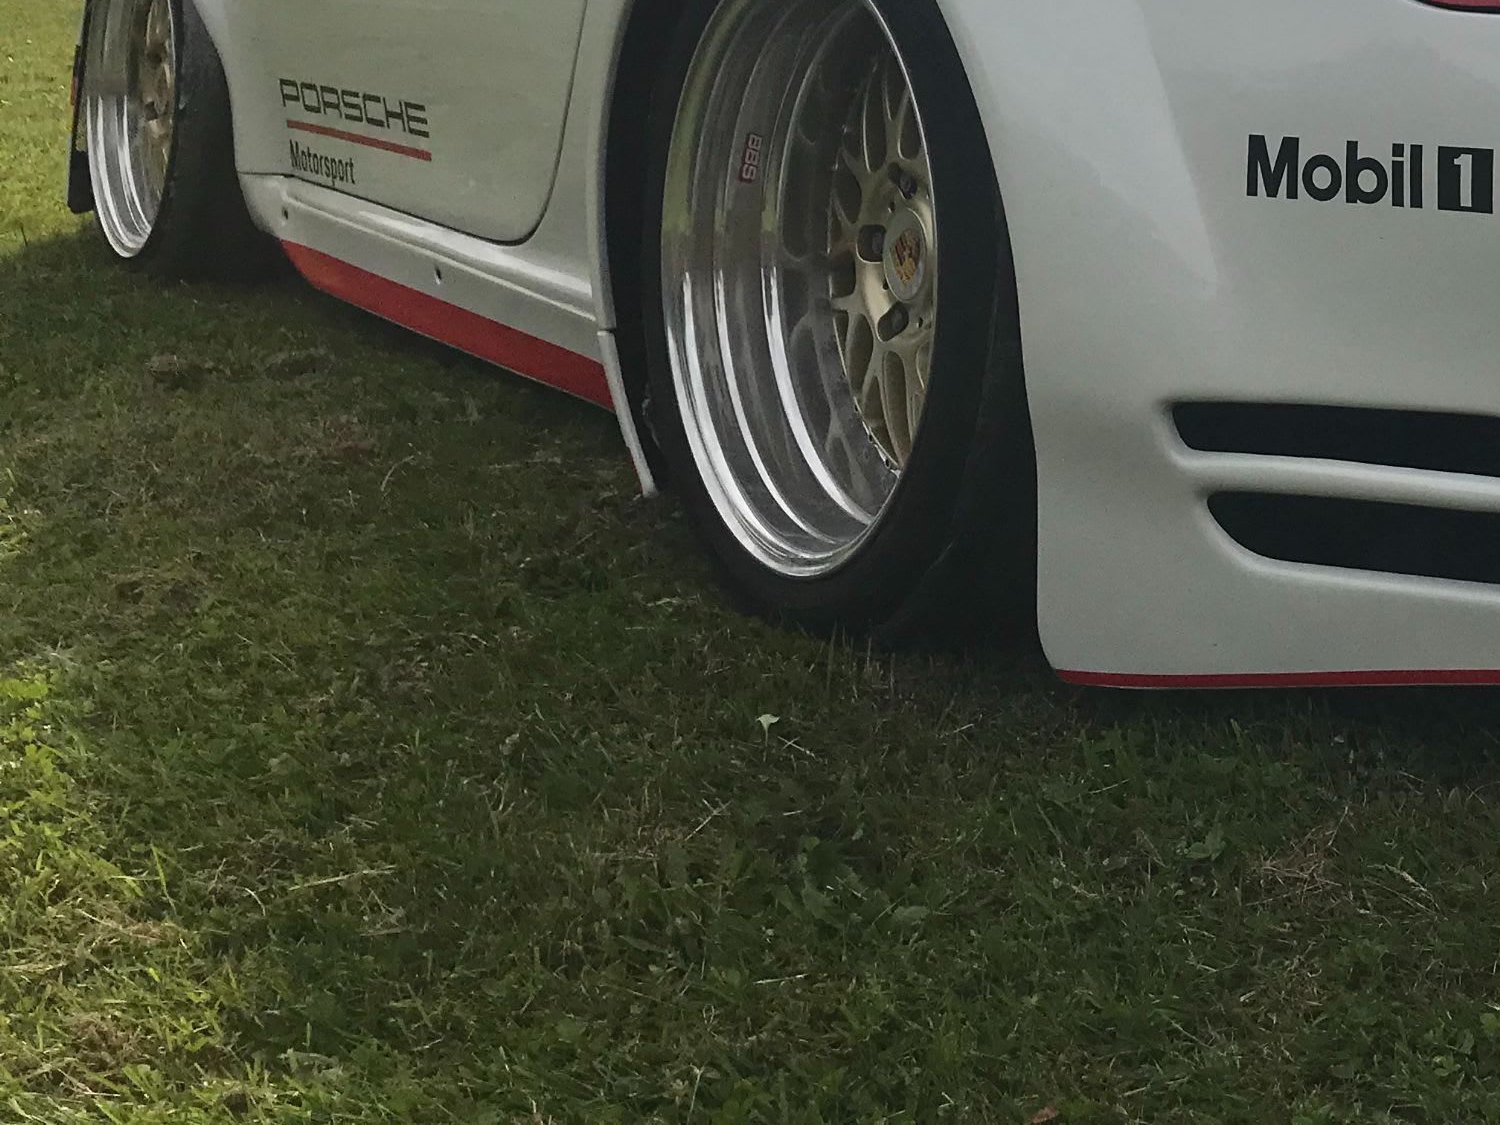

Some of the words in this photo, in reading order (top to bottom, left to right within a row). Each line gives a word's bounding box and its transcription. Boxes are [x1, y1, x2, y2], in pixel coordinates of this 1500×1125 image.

[279, 78, 430, 138] PORSCHE
[289, 139, 356, 187] Motorsport
[741, 132, 765, 181] BBS
[1246, 133, 1423, 209] Mobil
